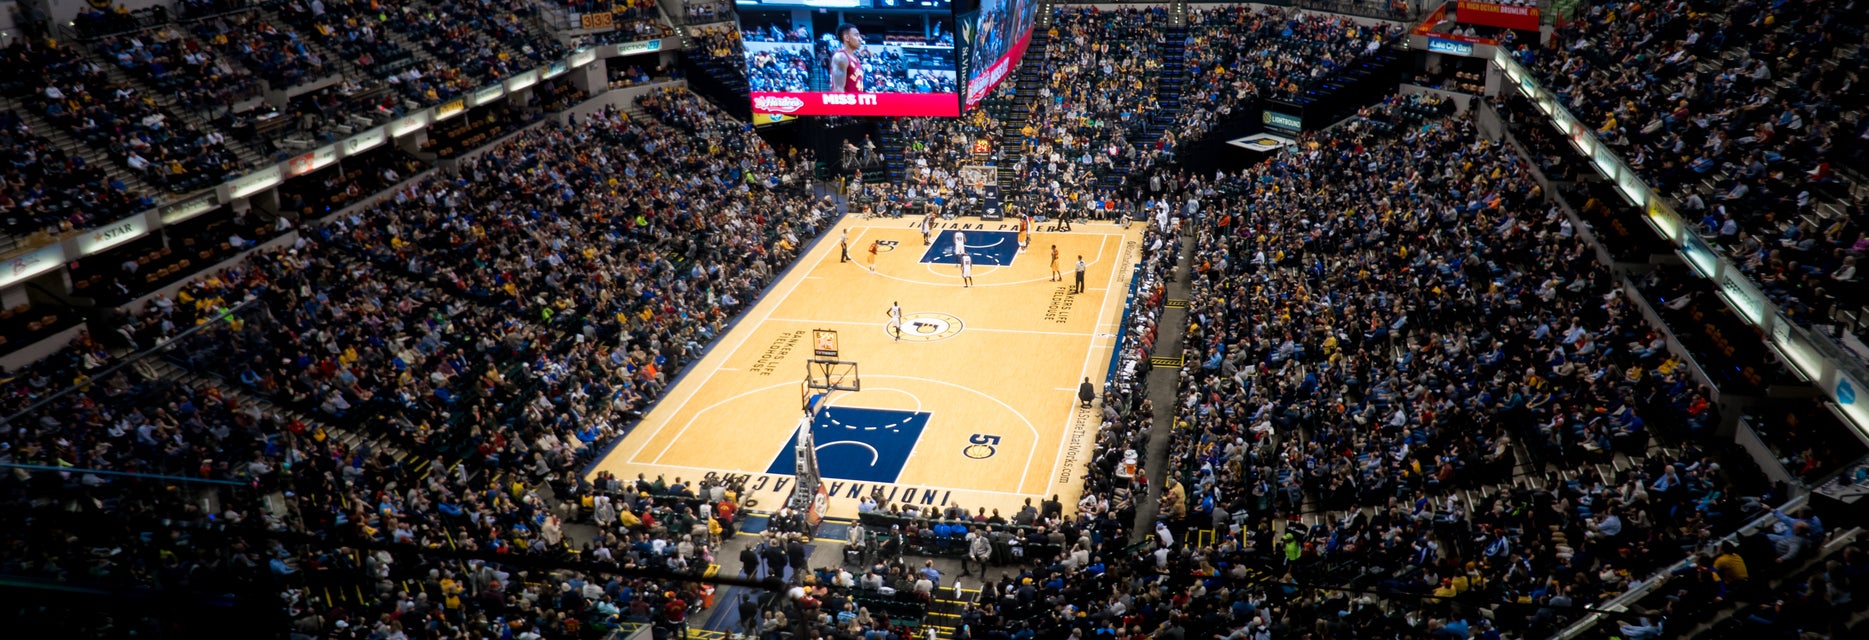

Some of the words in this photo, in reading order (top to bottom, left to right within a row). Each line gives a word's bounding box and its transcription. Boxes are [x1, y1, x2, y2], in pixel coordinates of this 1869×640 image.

[1480, 4, 1500, 13] OCTANE
[1500, 6, 1528, 16] DRUMLINE
[583, 12, 612, 28] 333
[1446, 42, 1457, 53] City
[1457, 44, 1472, 53] Bank
[961, 59, 969, 96] Vincent
[822, 93, 857, 105] MISS
[858, 94, 877, 105] IT!
[1271, 115, 1302, 128] LIGHTBOUND
[103, 223, 134, 241] STAR
[908, 221, 985, 231] IDIANA
[998, 224, 1071, 233] PAERS
[1044, 286, 1066, 320] FIELDHOUSE
[1061, 284, 1077, 310] BAKERS
[1055, 311, 1069, 324] LIFE
[749, 332, 791, 372] FIELDHOUSE
[773, 330, 806, 360] BANKERS
[760, 361, 780, 376] LIFE
